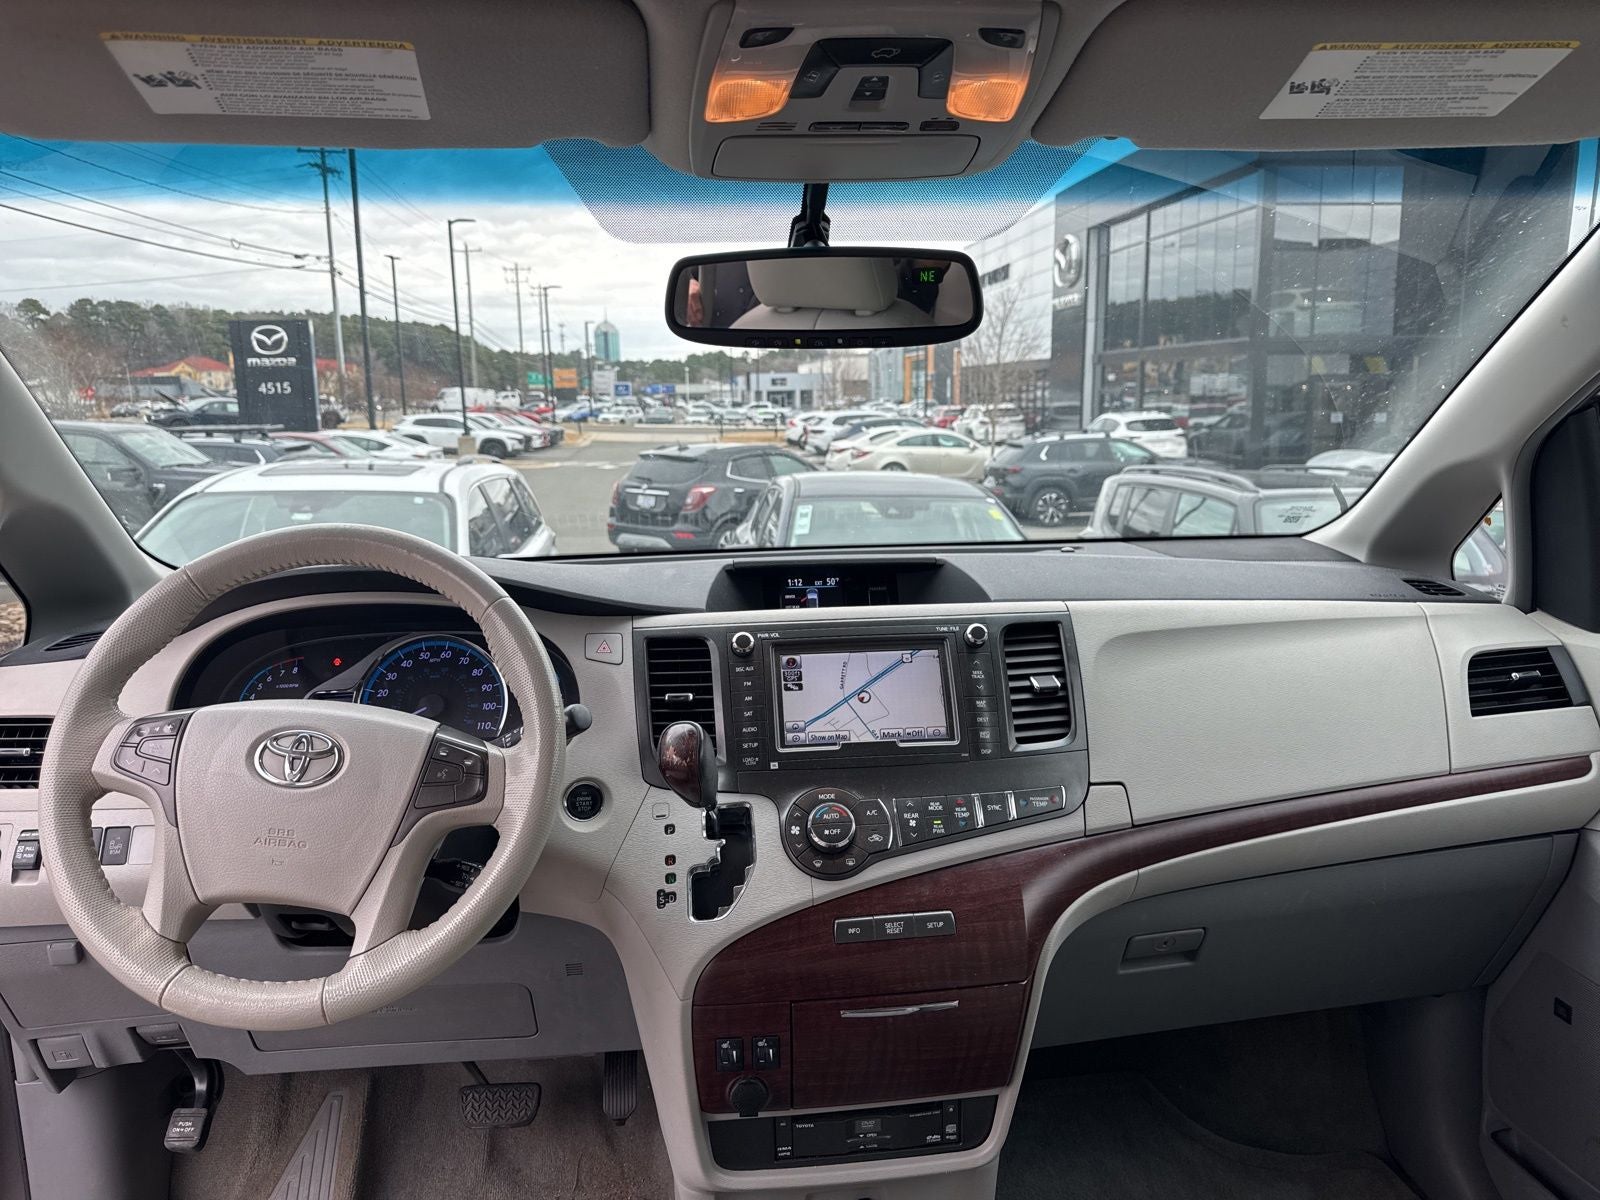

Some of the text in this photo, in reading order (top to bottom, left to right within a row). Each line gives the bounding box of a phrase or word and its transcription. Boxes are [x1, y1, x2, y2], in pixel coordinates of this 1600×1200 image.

[317, 39, 407, 50] ADVERTENCIA
[920, 270, 936, 283] NE
[258, 381, 292, 395] 4515
[787, 578, 803, 587] 1:12
[418, 652, 430, 660] 50
[440, 651, 452, 659] 60
[400, 660, 412, 668] 40
[385, 672, 398, 680] 30
[471, 668, 483, 676] 80
[481, 684, 493, 692] 90
[376, 689, 389, 697] 20
[482, 702, 496, 710] 100
[476, 722, 492, 730] 110
[836, 734, 848, 742] Map
[882, 730, 902, 738] Mark
[254, 837, 308, 849] AIRBAG
